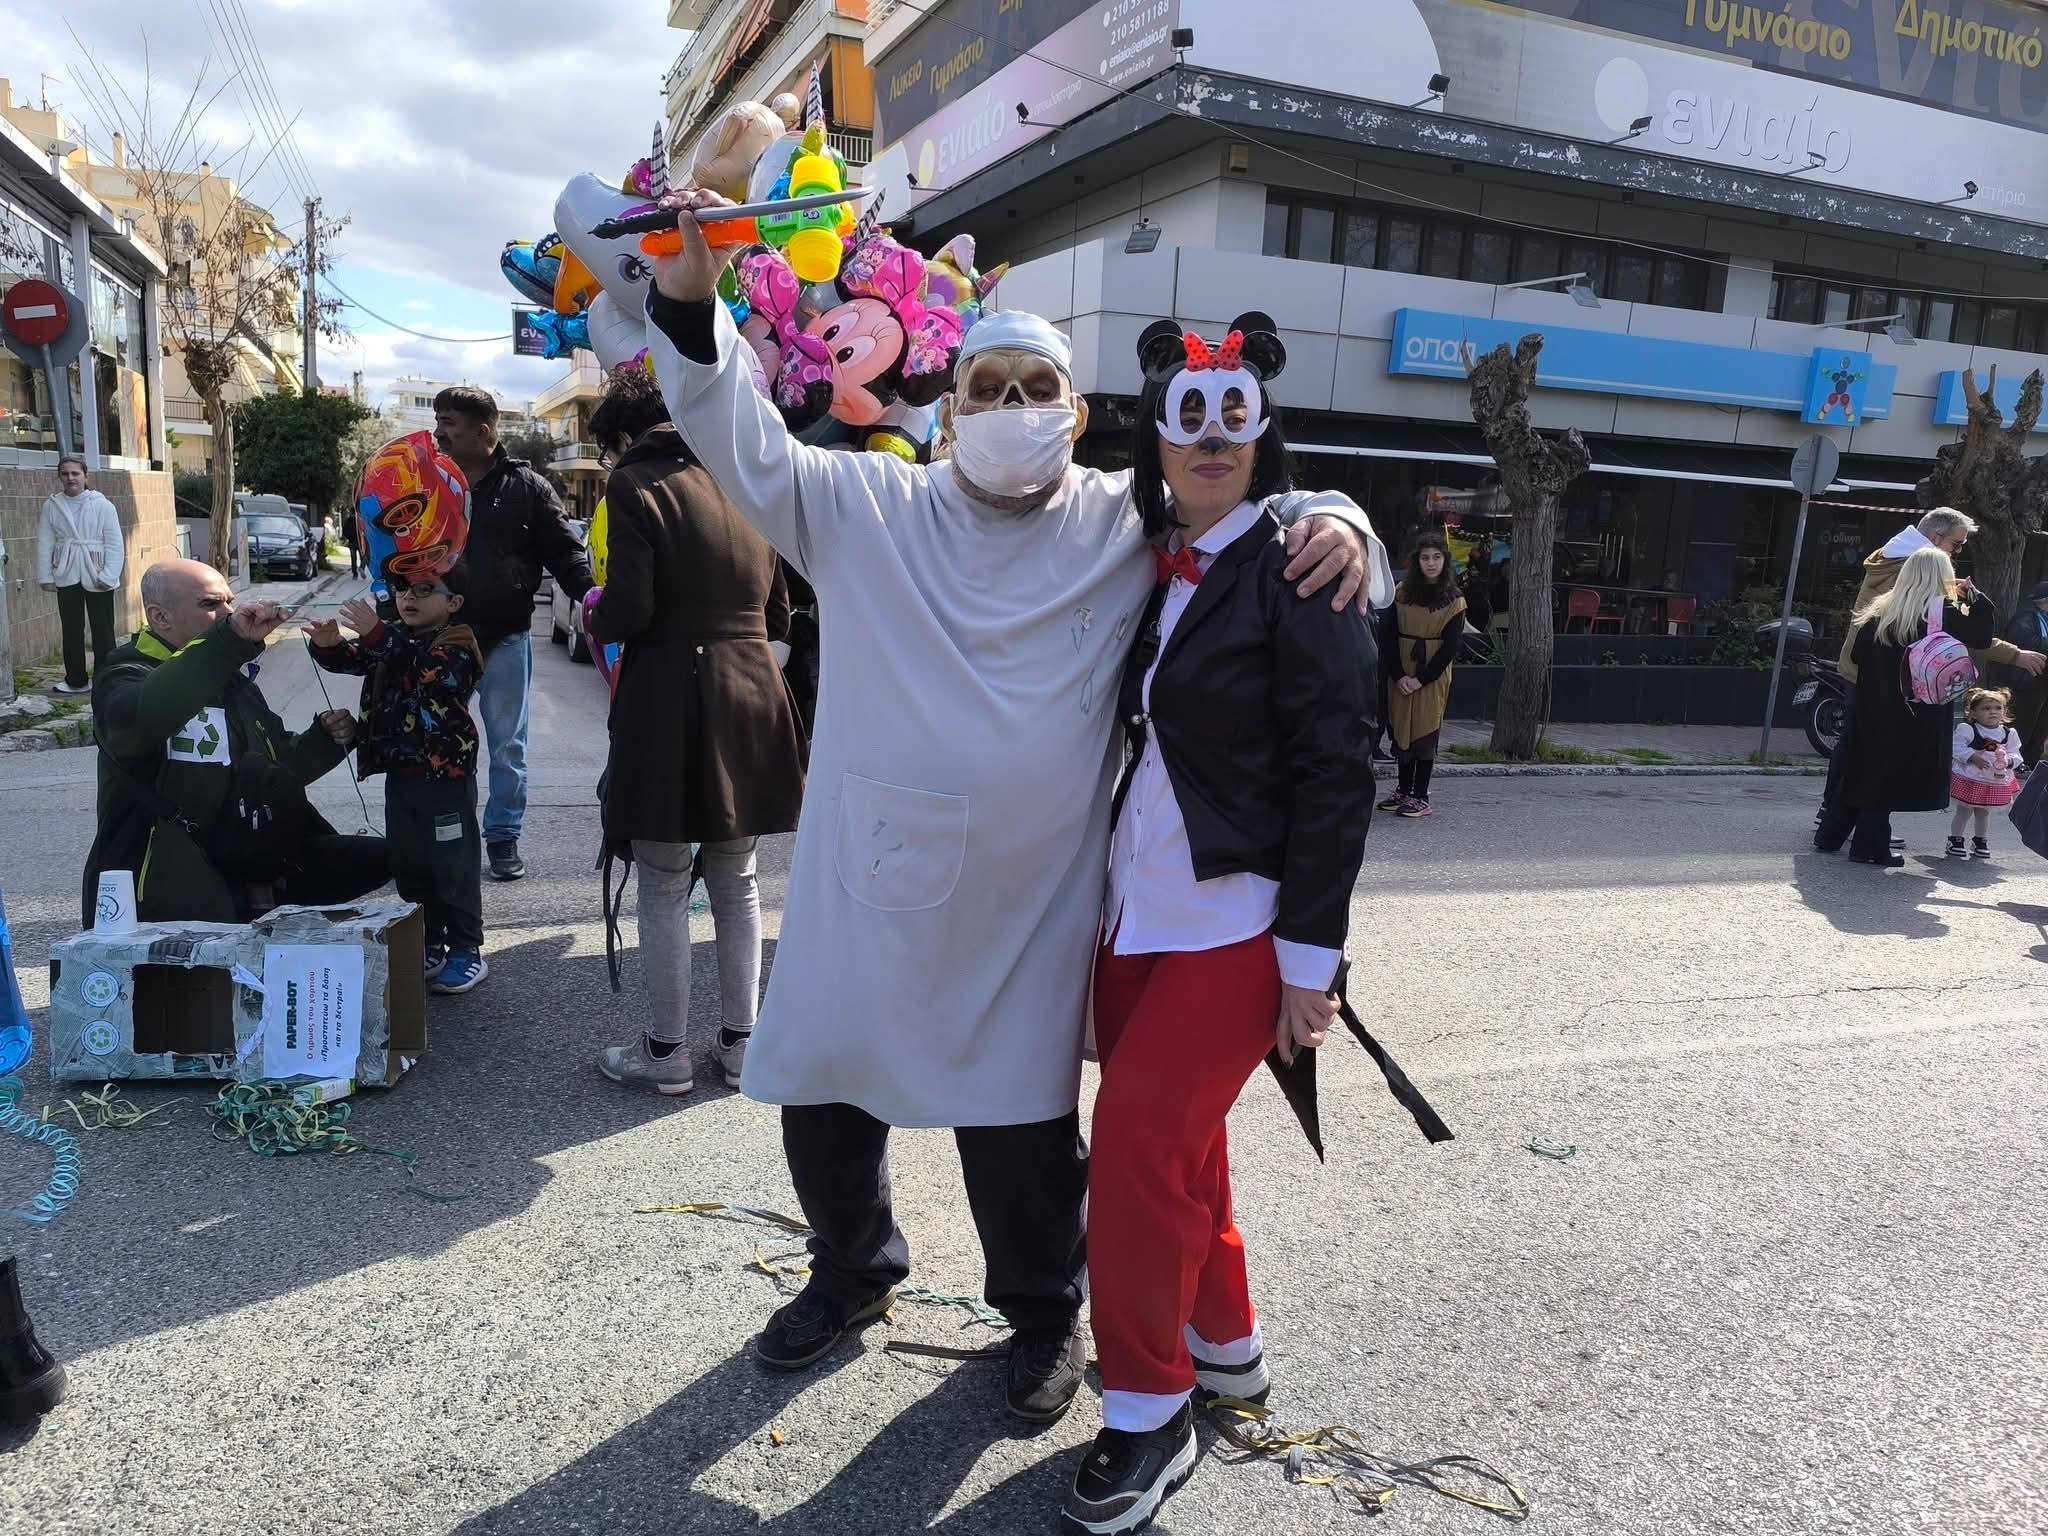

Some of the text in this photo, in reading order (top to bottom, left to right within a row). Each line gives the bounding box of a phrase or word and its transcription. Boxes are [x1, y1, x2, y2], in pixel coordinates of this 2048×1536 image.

[1111, 25, 1126, 46] 210
[1894, 0, 2043, 68] Δημοτικό
[889, 59, 923, 103] Λύκειο
[930, 37, 985, 95] Γυμνάσιο
[938, 91, 1006, 174] ενιαίο
[1663, 89, 1851, 173] ενιαίο
[286, 980, 297, 1049] PAPER-BOT
[322, 992, 329, 1001] τα
[336, 1022, 342, 1031] τα
